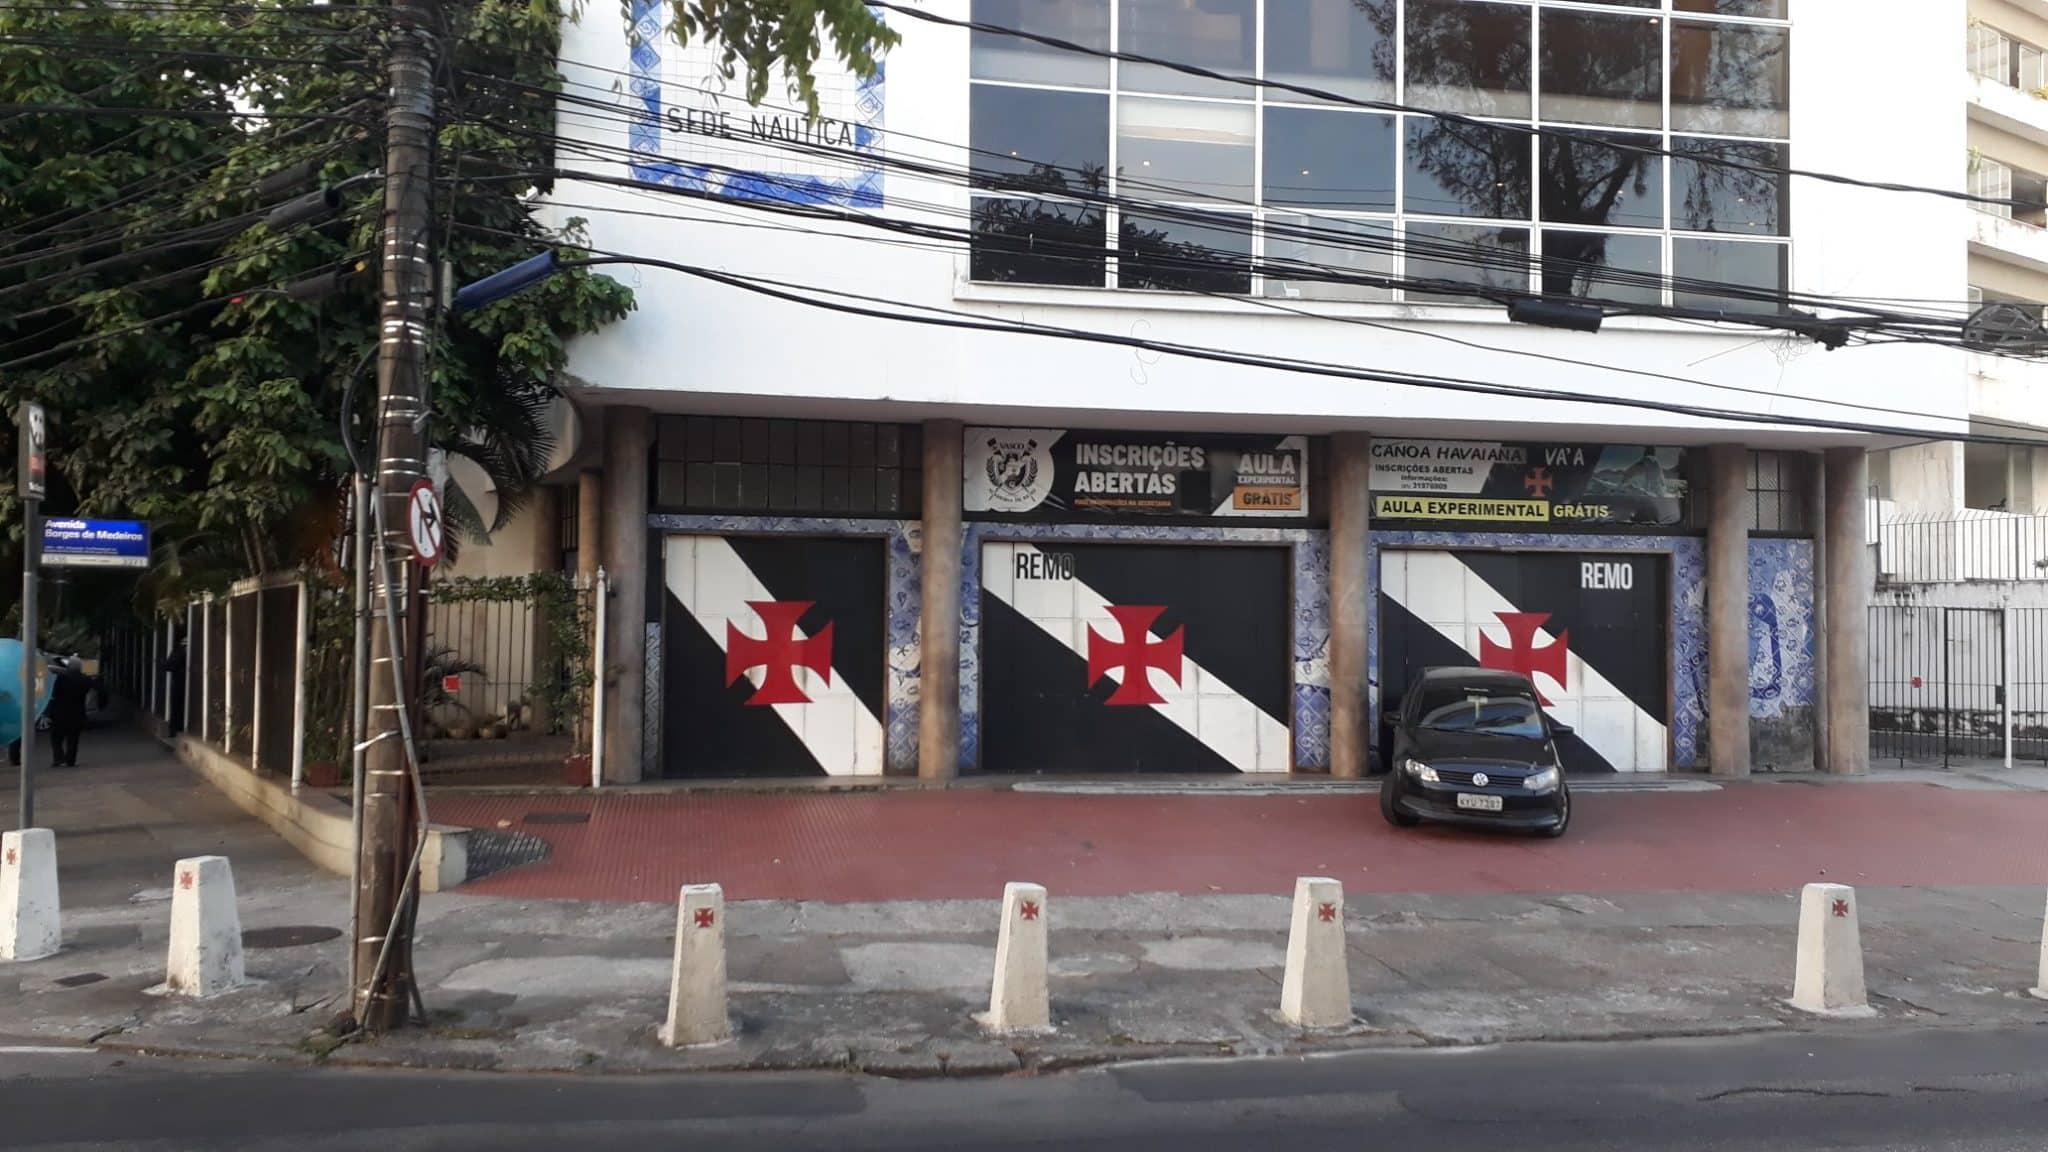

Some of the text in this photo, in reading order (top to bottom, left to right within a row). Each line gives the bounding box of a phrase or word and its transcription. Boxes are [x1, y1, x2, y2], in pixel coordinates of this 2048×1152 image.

[667, 107, 731, 138] SEDE
[999, 441, 1025, 450] VASCO
[1371, 444, 1431, 459] CANOA
[1437, 447, 1522, 462] HAVAIANA
[1076, 441, 1205, 471] INSCRIÇÕES
[1239, 453, 1295, 474] AULA
[1375, 463, 1474, 475] INSCRIÇÕES ABERTAS
[1074, 471, 1176, 495] ABERTAS
[1382, 499, 1609, 518] AULA EXPERIMENTAL GRÁTIS
[45, 519, 87, 530] Avenida
[45, 529, 144, 541] Borges de Medeiros
[1016, 552, 1074, 581] REMO
[1581, 562, 1633, 590] REMO
